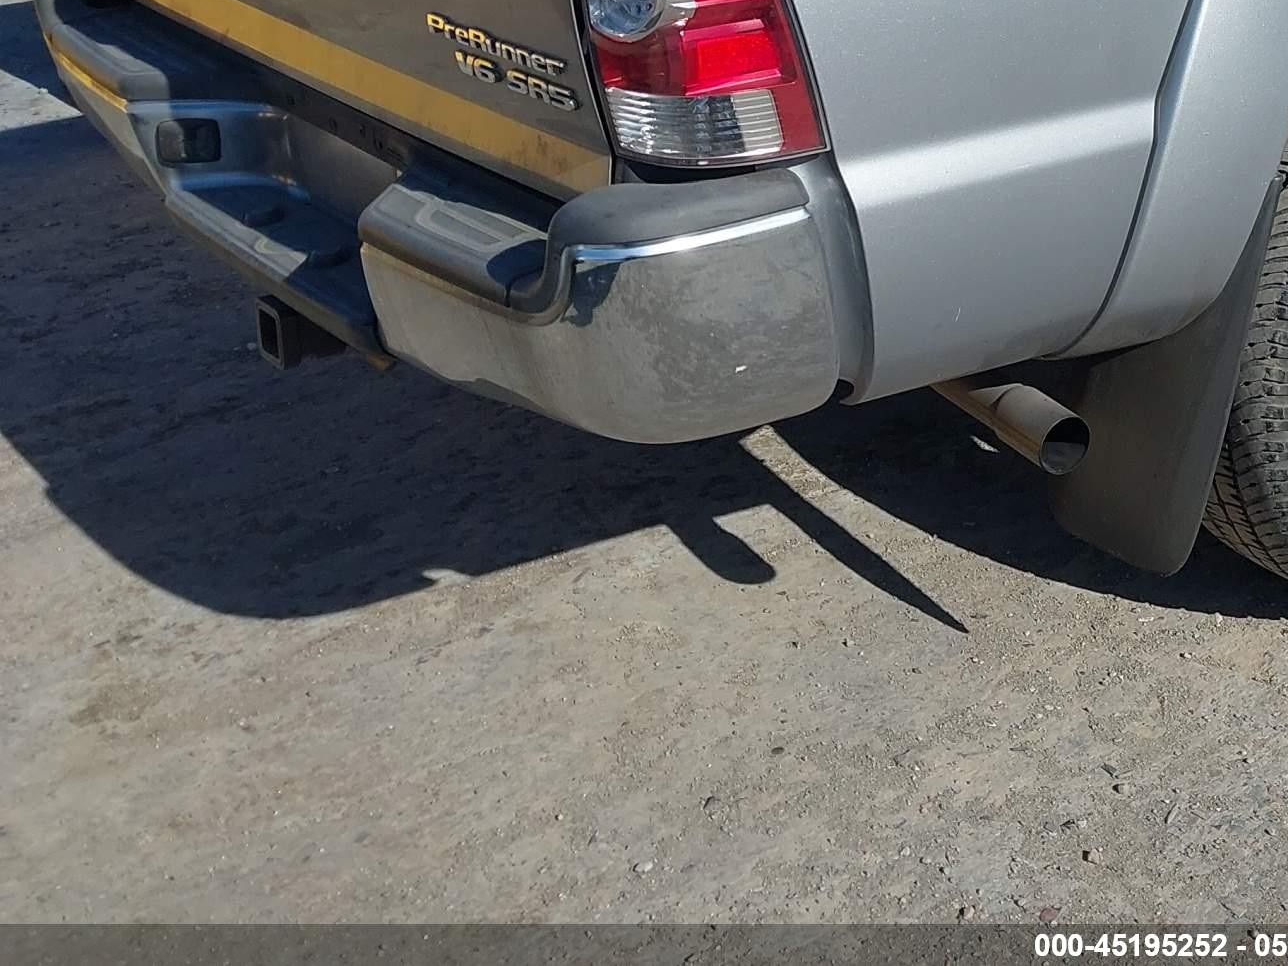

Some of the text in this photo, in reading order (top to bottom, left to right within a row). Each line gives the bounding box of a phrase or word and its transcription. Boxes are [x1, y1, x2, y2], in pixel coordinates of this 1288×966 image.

[426, 12, 566, 77] PreRunner
[455, 49, 578, 112] V6 SR5
